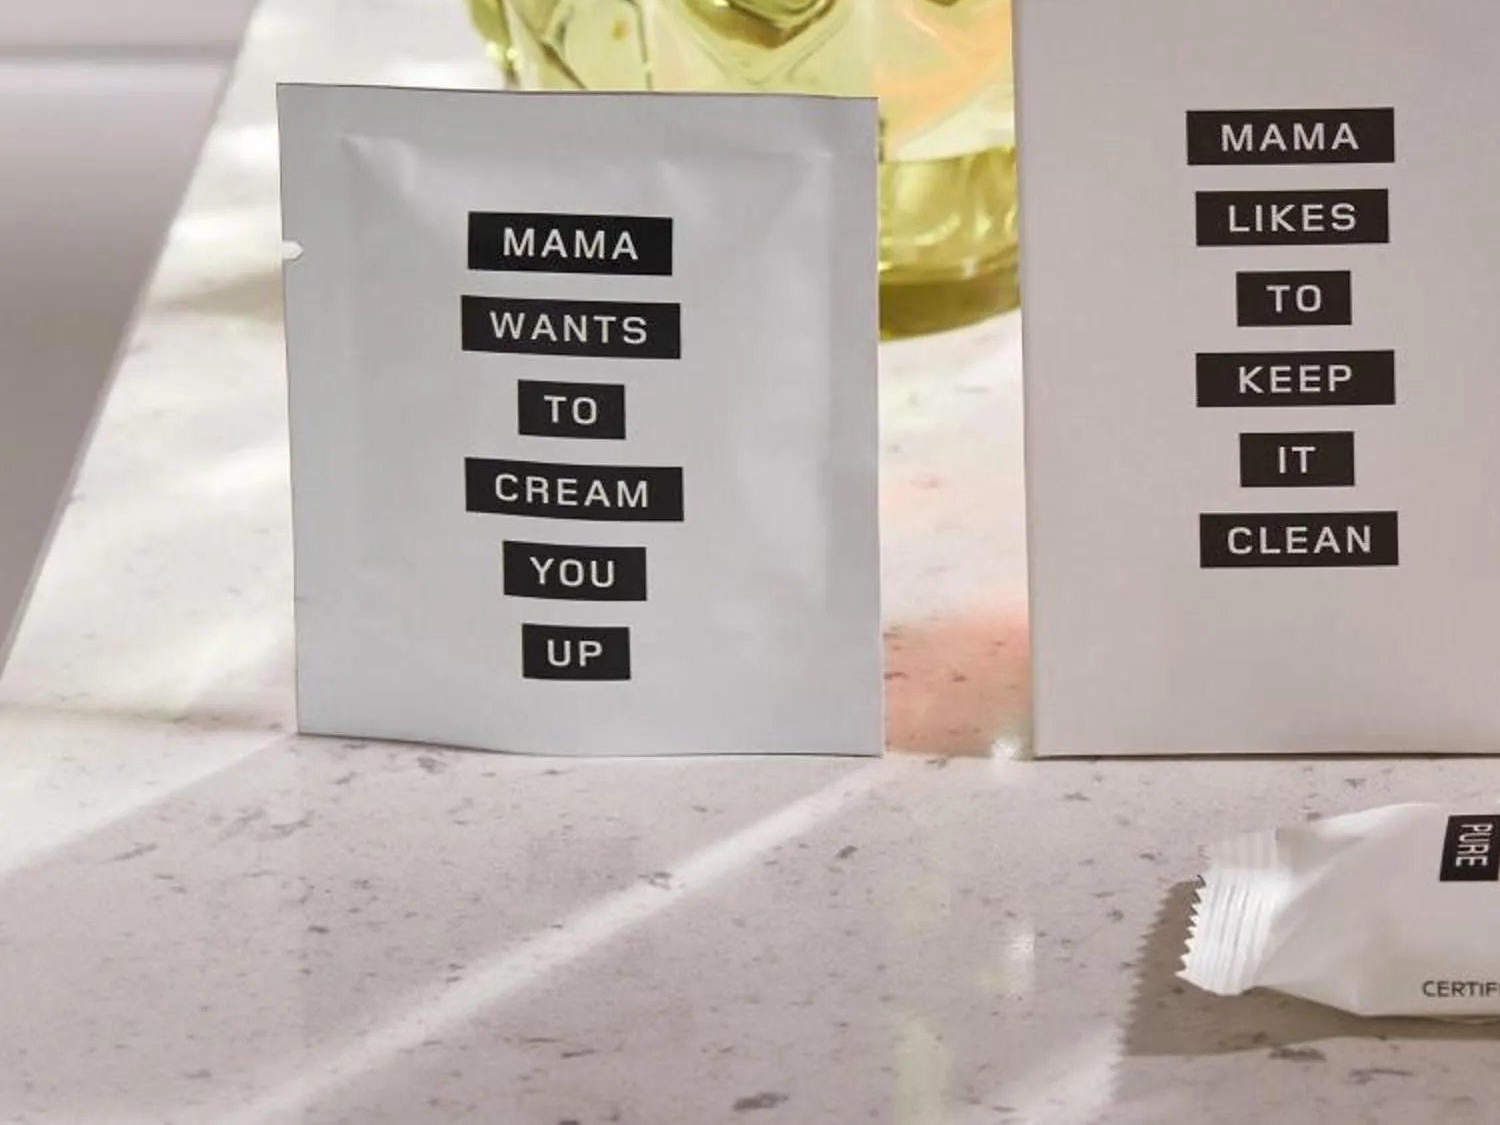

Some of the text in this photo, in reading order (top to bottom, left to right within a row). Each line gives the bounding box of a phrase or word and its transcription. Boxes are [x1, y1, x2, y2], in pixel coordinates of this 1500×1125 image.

[1221, 122, 1359, 152] MAMA
[1228, 202, 1356, 232] LIKES
[503, 227, 639, 260] MAMA
[1266, 284, 1321, 313] TO
[489, 311, 647, 345] WANTS
[1239, 364, 1352, 394] KEEP
[543, 394, 597, 425] TO
[1279, 446, 1316, 474] IT
[495, 473, 648, 508] CREAM
[1227, 525, 1371, 555] CLEAN
[529, 556, 614, 588] YOU
[547, 639, 603, 667] UP
[1455, 822, 1495, 867] PURE
